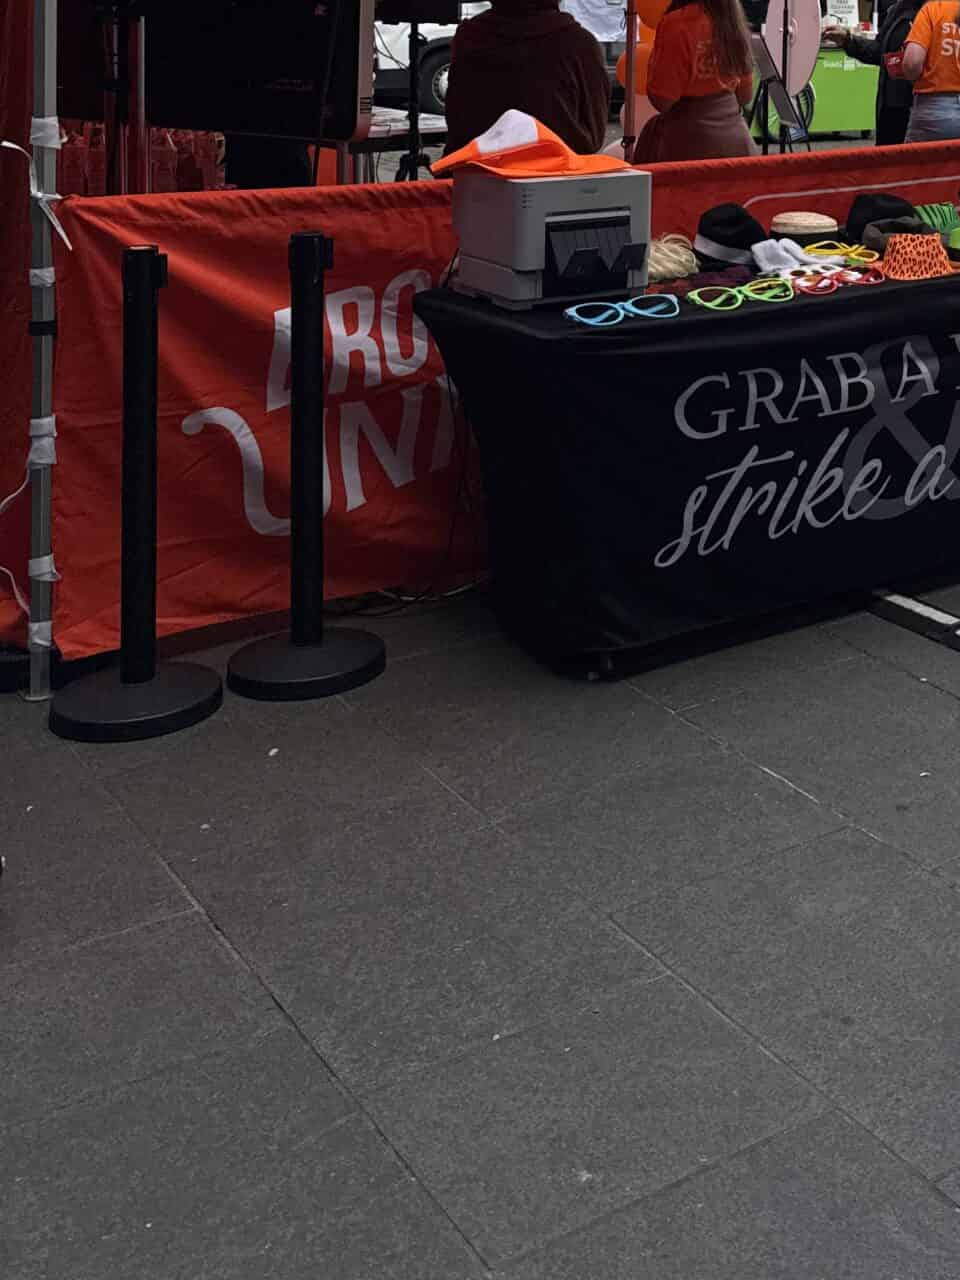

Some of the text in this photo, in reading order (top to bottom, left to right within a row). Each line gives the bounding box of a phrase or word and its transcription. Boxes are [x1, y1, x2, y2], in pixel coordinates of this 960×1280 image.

[674, 351, 877, 440] GRAB
[890, 340, 940, 403] A
[654, 427, 890, 568] strike
[904, 443, 956, 507] a
